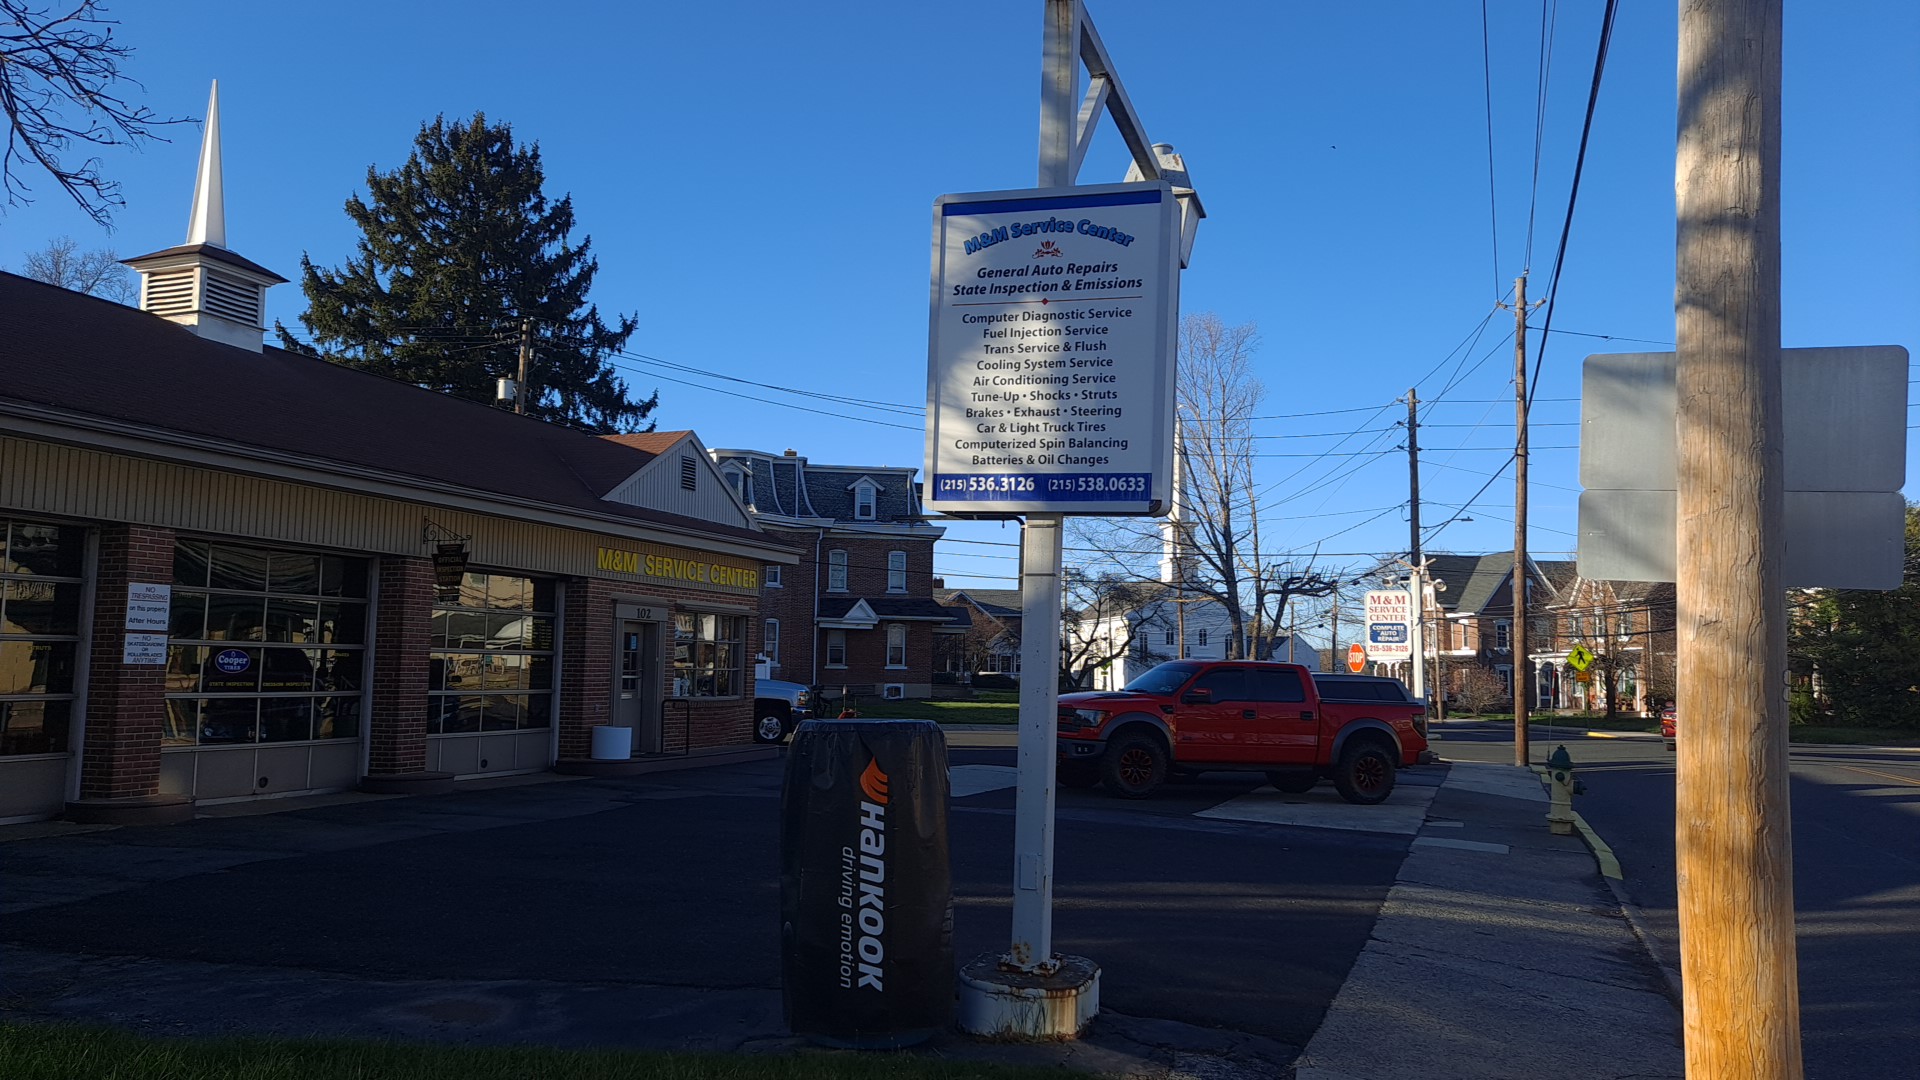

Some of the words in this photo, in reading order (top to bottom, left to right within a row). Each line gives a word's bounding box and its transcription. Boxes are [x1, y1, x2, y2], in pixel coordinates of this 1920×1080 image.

[964, 226, 1009, 255] M&M
[1010, 217, 1074, 238] Service
[1077, 219, 1135, 247] Center
[977, 265, 1029, 278] General
[1031, 264, 1063, 276] Auto
[1067, 261, 1118, 276] Repairs
[953, 284, 987, 296] State
[990, 281, 1058, 296] Inspection
[1062, 280, 1072, 291] &
[1075, 278, 1142, 290] Emissions
[962, 313, 1019, 325] Computer
[1022, 309, 1084, 323] Diagnostic
[1088, 308, 1132, 319] Service
[983, 328, 1007, 339] Fuel
[1010, 327, 1061, 340] Injection
[1065, 325, 1108, 336] Service
[984, 344, 1014, 355] Trans
[1018, 342, 1060, 353] Service
[1063, 342, 1072, 352] &
[1075, 340, 1106, 352] Flush
[977, 360, 1020, 371] Cooling
[1024, 359, 1066, 371] System
[1069, 357, 1113, 368] Service
[974, 376, 989, 386] Air
[992, 374, 1069, 387] Conditioning
[1072, 373, 1116, 384] Service
[971, 392, 1020, 403] Tune-Up
[1030, 390, 1070, 401] Shocks
[1082, 389, 1117, 399] Struts
[966, 408, 1004, 418] Brakes
[1014, 406, 1060, 417] Exhaust
[1071, 406, 1122, 418] Steering
[977, 423, 995, 433] Car
[999, 423, 1007, 433] &
[1010, 422, 1040, 435] Light
[1043, 422, 1074, 432] Truck
[1077, 422, 1106, 432] Tires
[955, 439, 1036, 451] Computerized
[1039, 438, 1065, 450] Spin
[1069, 437, 1128, 450] Balancing
[972, 455, 1023, 465] Batteries
[1026, 455, 1035, 465] &
[1038, 454, 1054, 464] Oil
[1057, 454, 1109, 466] Changes
[940, 479, 966, 491] (215)
[969, 477, 1035, 491] 536.3126
[1048, 479, 1075, 492] (215)
[1078, 477, 1145, 491] 538.0633
[598, 548, 639, 573] M&M
[644, 555, 703, 582] SERVICE
[710, 564, 757, 588] CENTER
[1370, 596, 1380, 604] M
[1383, 596, 1392, 605] &
[1395, 596, 1406, 604] M
[636, 608, 651, 618] 102
[218, 656, 248, 665] Cooper
[1349, 652, 1363, 663] STOP
[838, 846, 856, 909] driving
[840, 914, 852, 988] emotion
